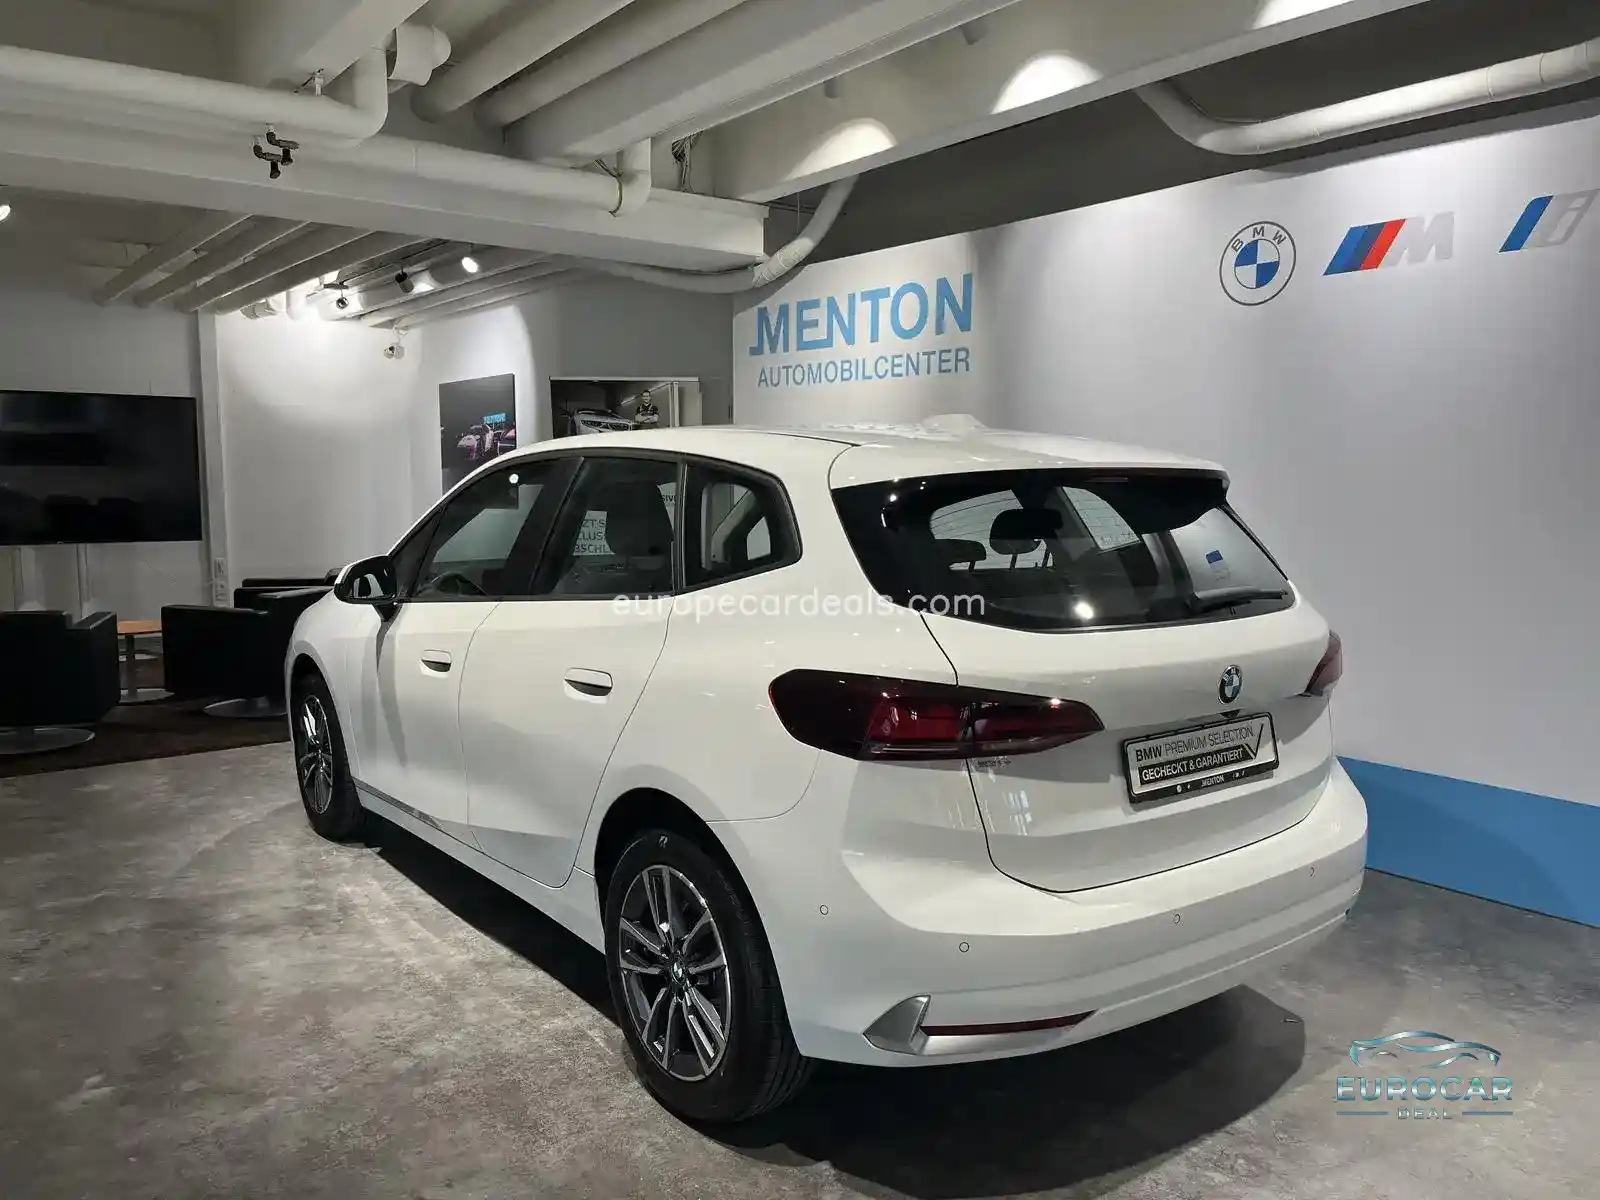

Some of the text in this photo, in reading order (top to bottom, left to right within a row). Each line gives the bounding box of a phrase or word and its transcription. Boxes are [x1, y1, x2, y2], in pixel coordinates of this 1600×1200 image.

[1231, 225, 1286, 252] BMW
[749, 273, 973, 356] MENTON
[757, 346, 971, 388] AUTOMOBILCENTER
[1135, 745, 1162, 762] BMW
[1164, 735, 1207, 757] PREMIUM
[1142, 748, 1244, 781] GECHECKT & GARANTIERT
